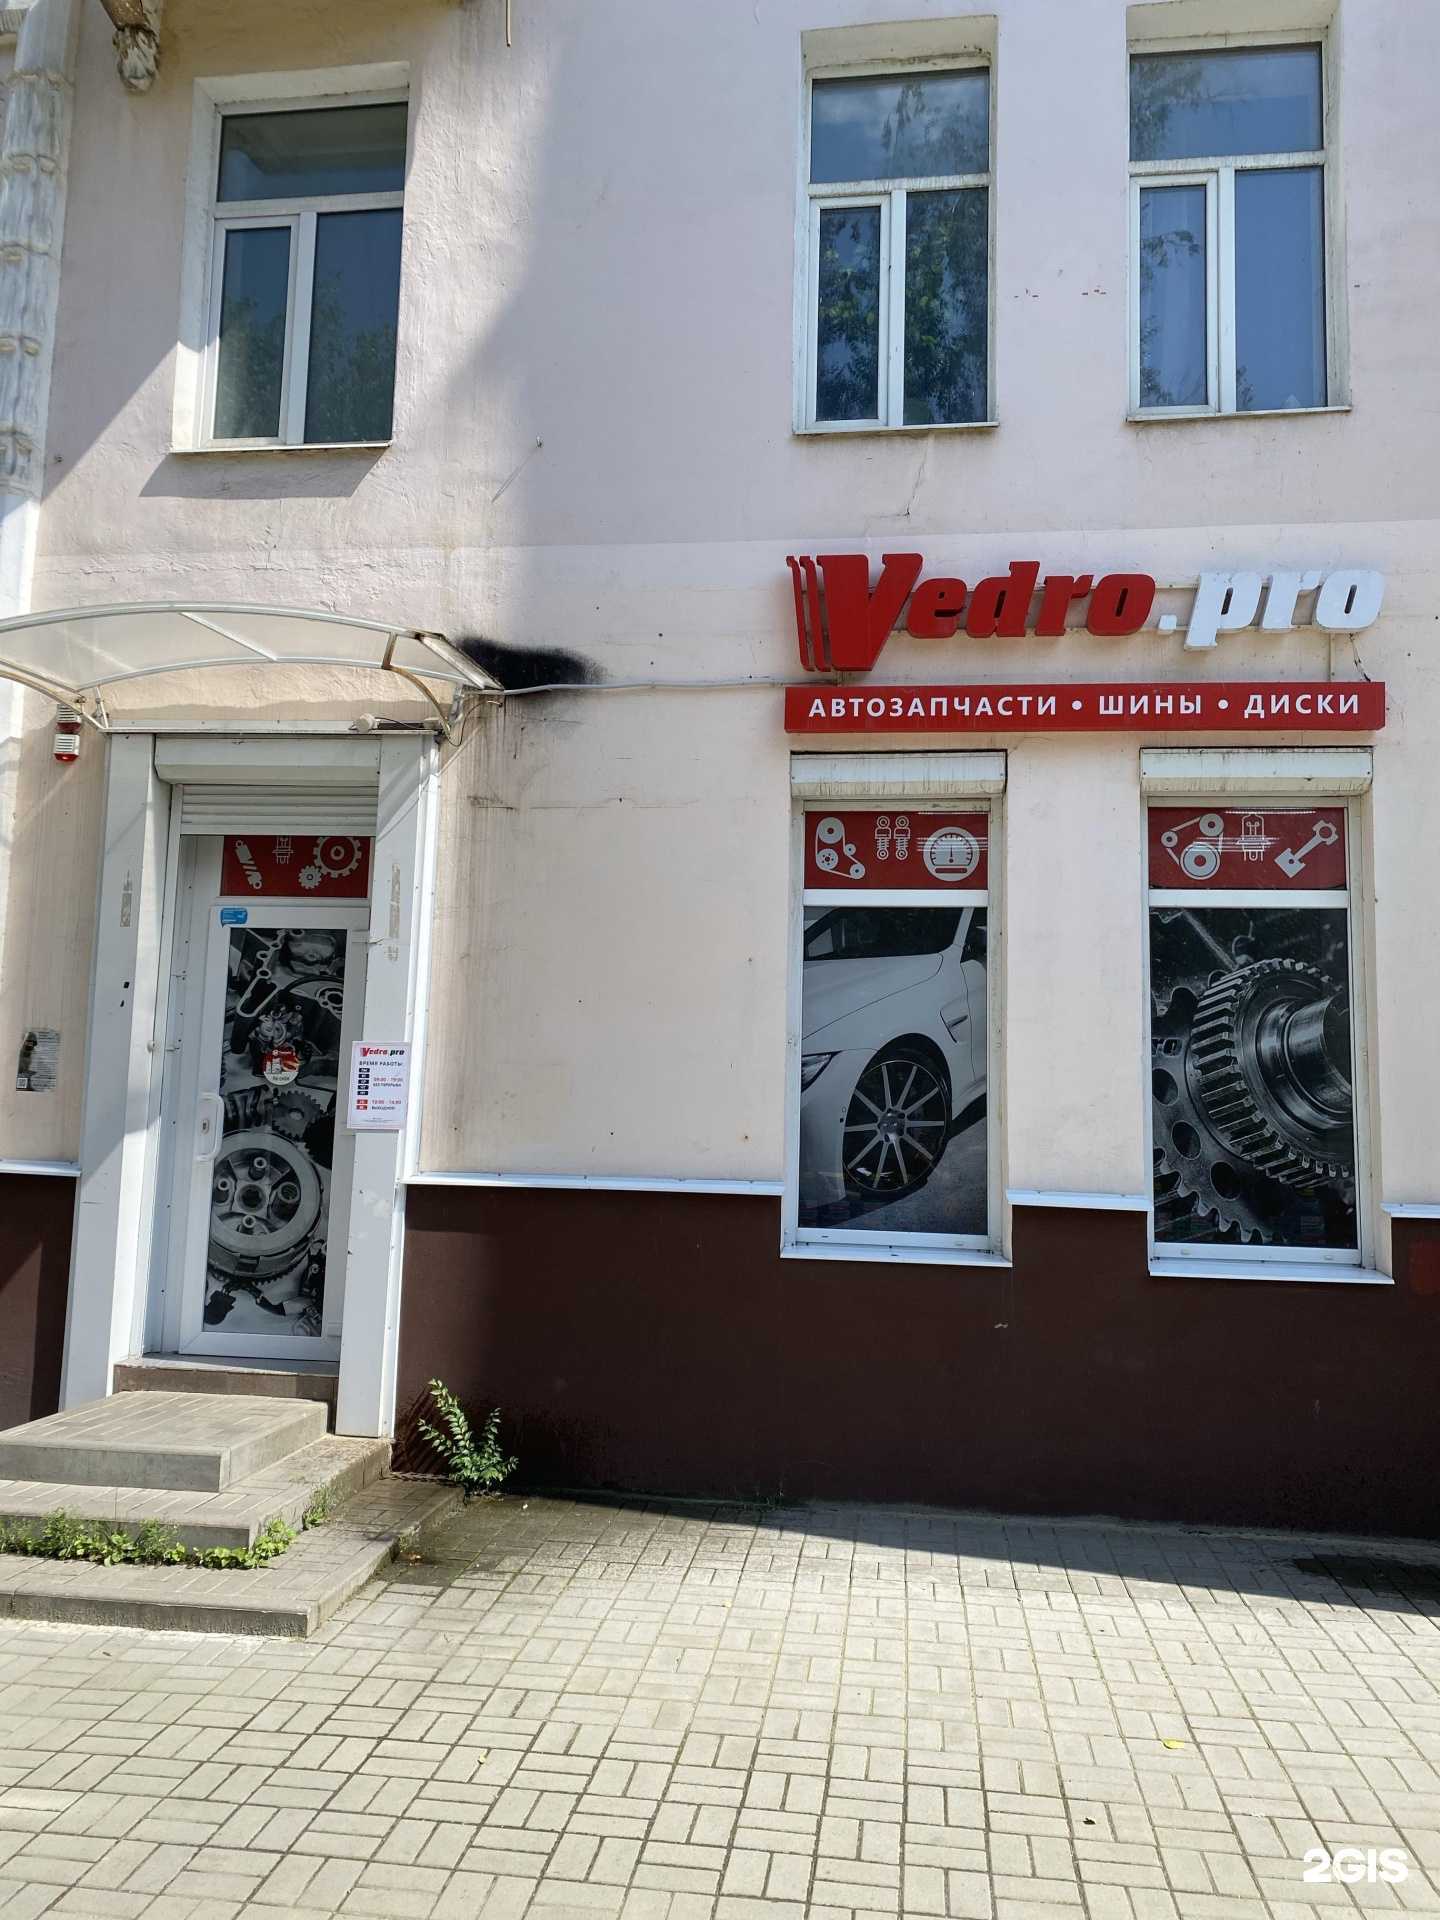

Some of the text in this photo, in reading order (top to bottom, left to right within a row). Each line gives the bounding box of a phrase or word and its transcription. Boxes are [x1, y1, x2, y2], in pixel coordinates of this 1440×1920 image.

[786, 553, 1384, 672] Vedro.pro
[808, 694, 1359, 719] АВТОЗАПЧАСТИ ШИНЫ ДИСКИ
